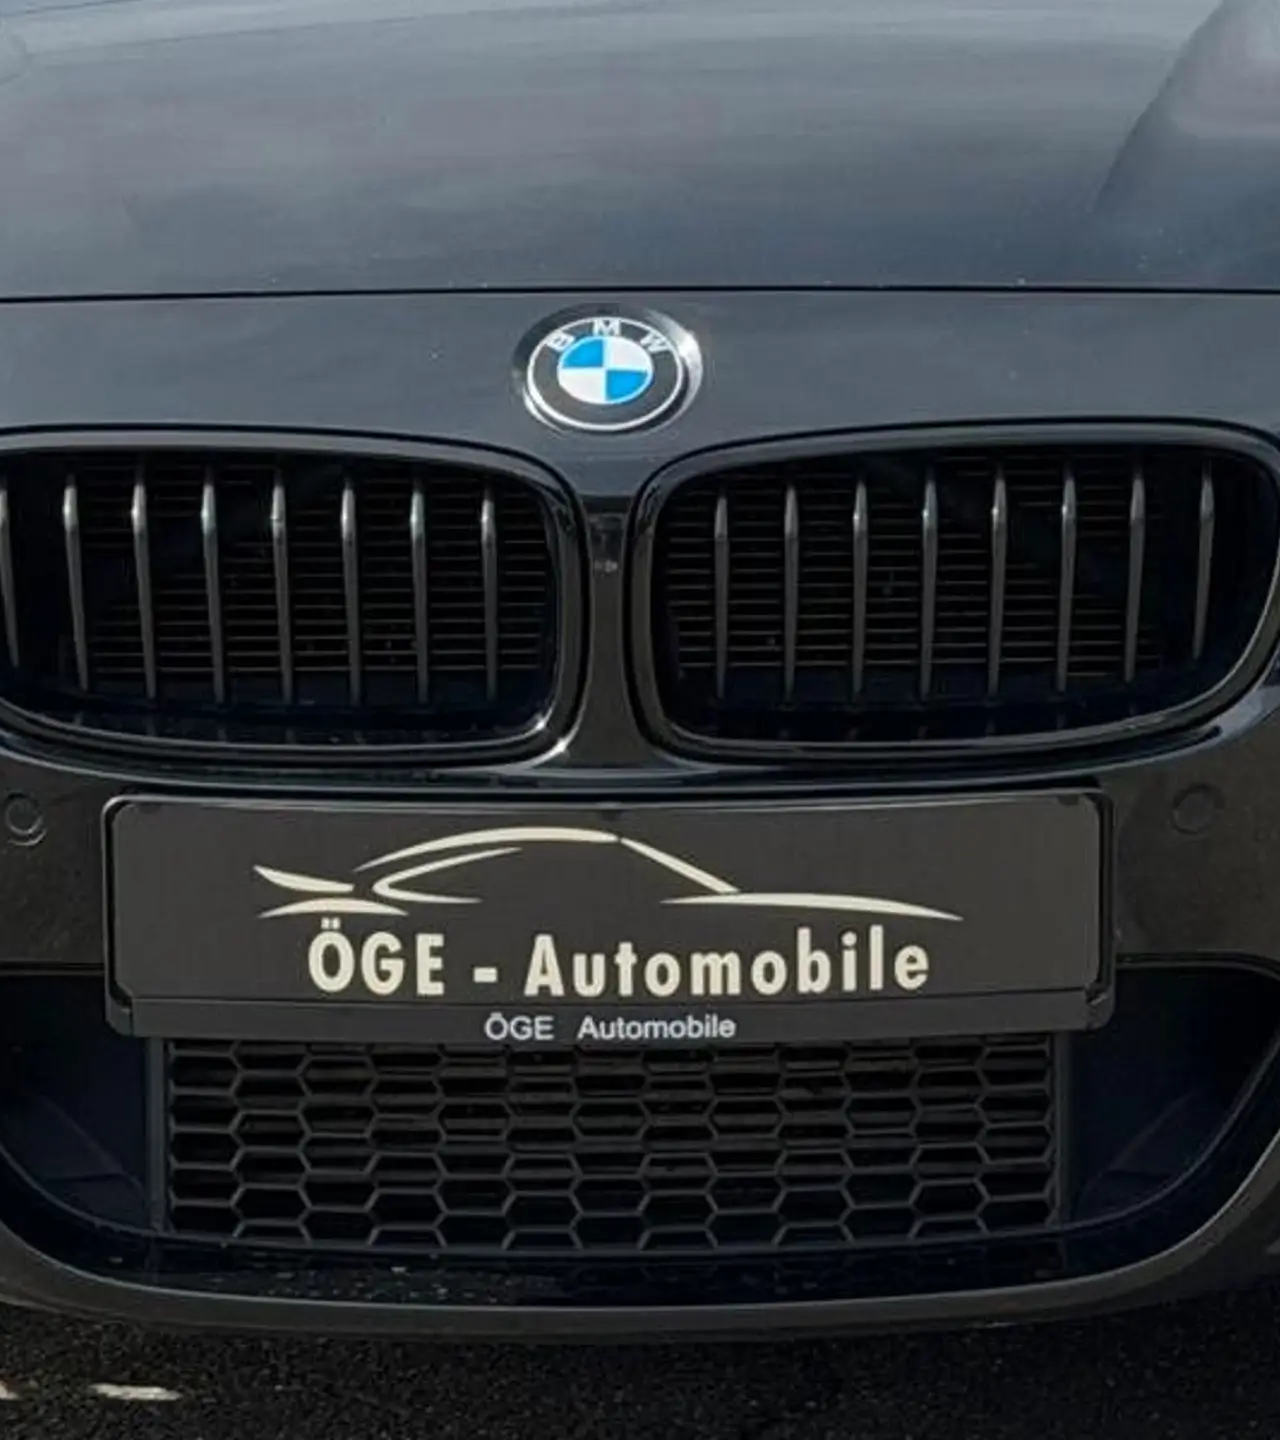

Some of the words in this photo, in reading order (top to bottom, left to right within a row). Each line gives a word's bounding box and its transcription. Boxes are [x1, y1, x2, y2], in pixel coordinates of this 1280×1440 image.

[546, 318, 671, 354] BMW
[308, 917, 445, 996] ÖGE
[524, 924, 929, 998] Automobile
[484, 1012, 554, 1041] ÖGE
[577, 1014, 736, 1040] Automobile
